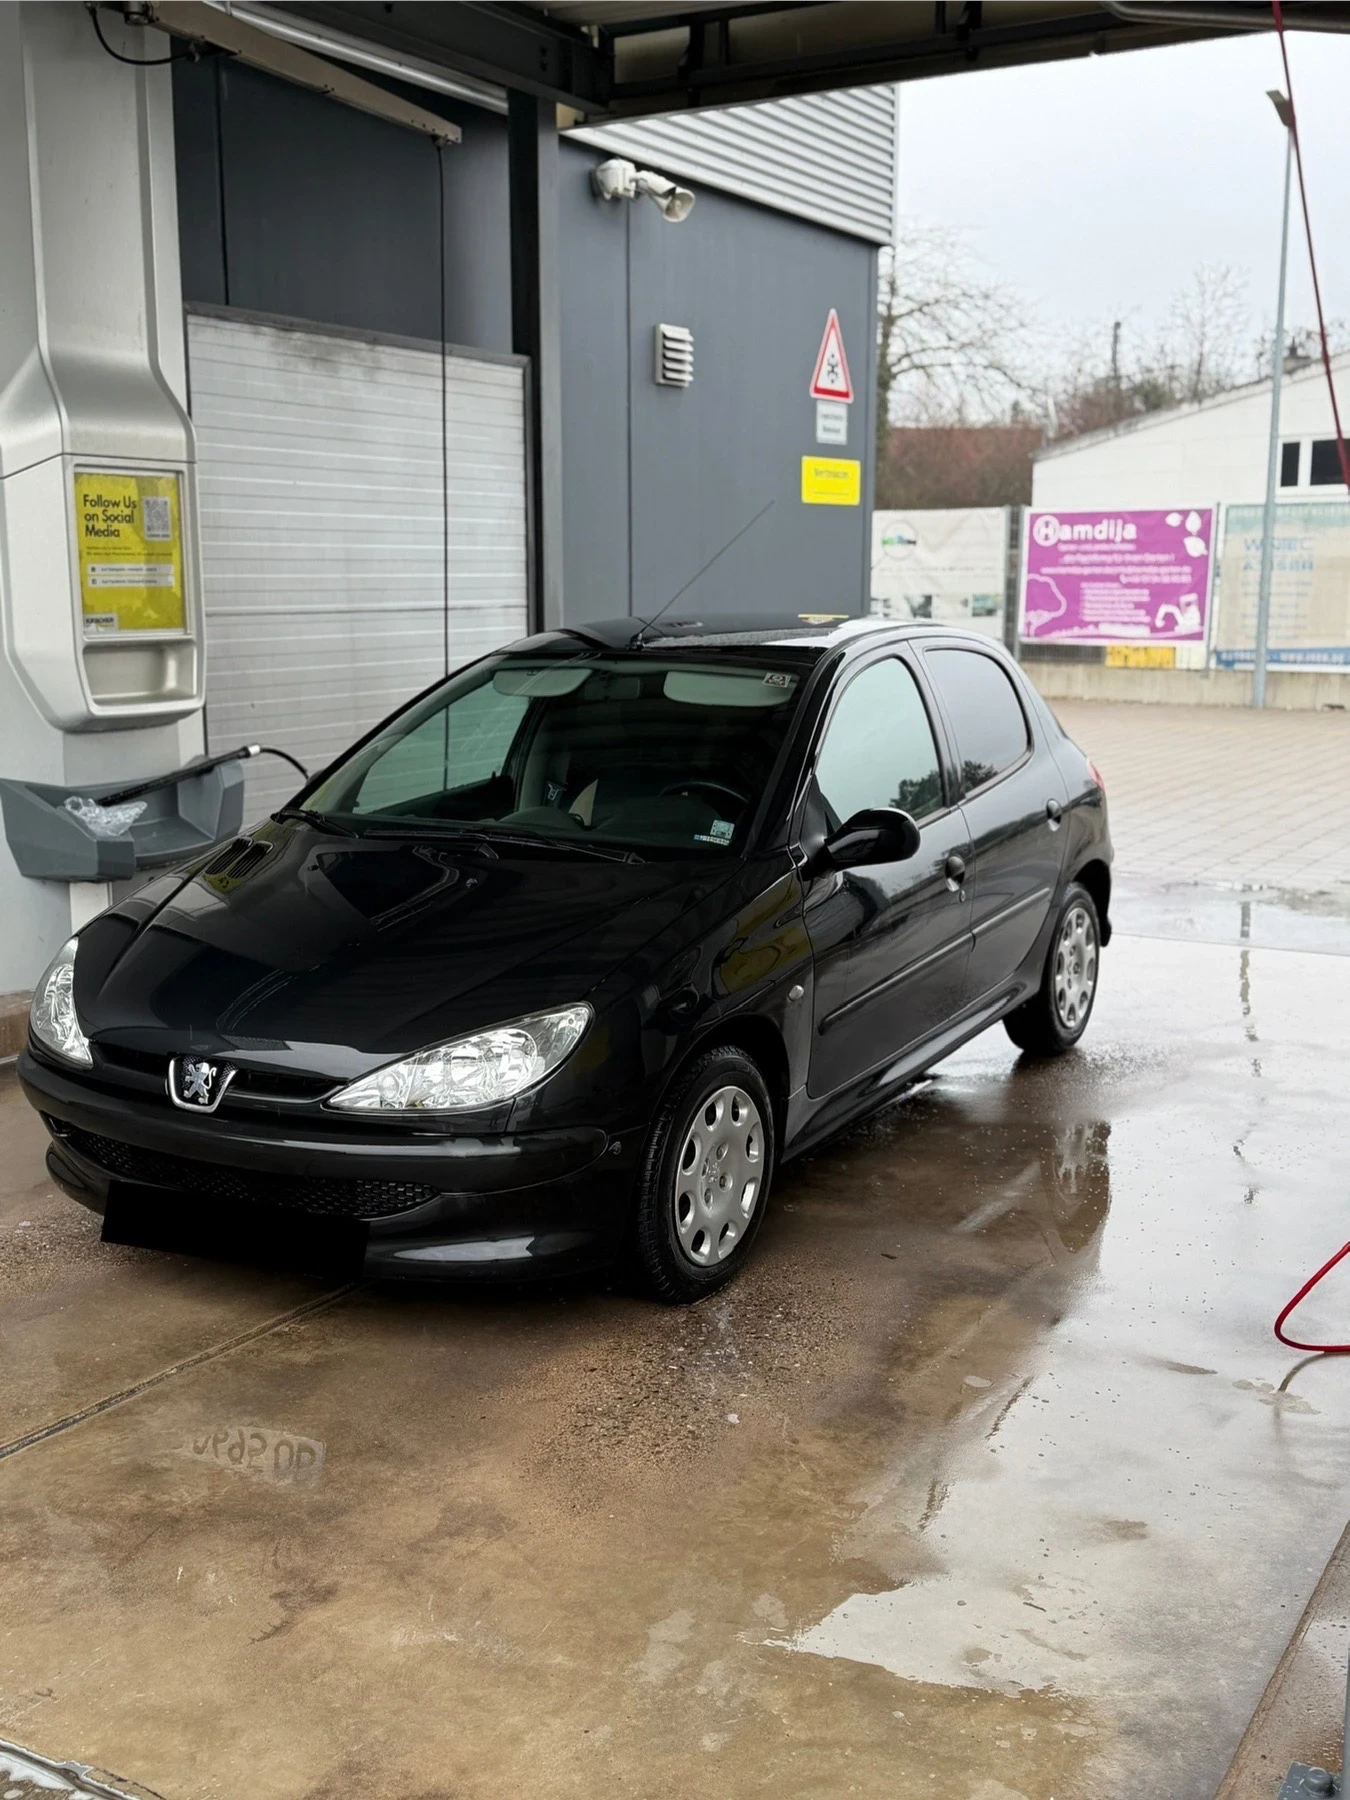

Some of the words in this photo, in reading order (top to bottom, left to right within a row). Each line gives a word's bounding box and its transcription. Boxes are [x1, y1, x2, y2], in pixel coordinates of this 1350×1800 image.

[83, 494, 121, 508] Follow
[123, 496, 137, 509] Us
[84, 512, 99, 522] on
[102, 509, 135, 524] Social
[85, 524, 120, 538] Media
[1034, 516, 1137, 544] Hamdija
